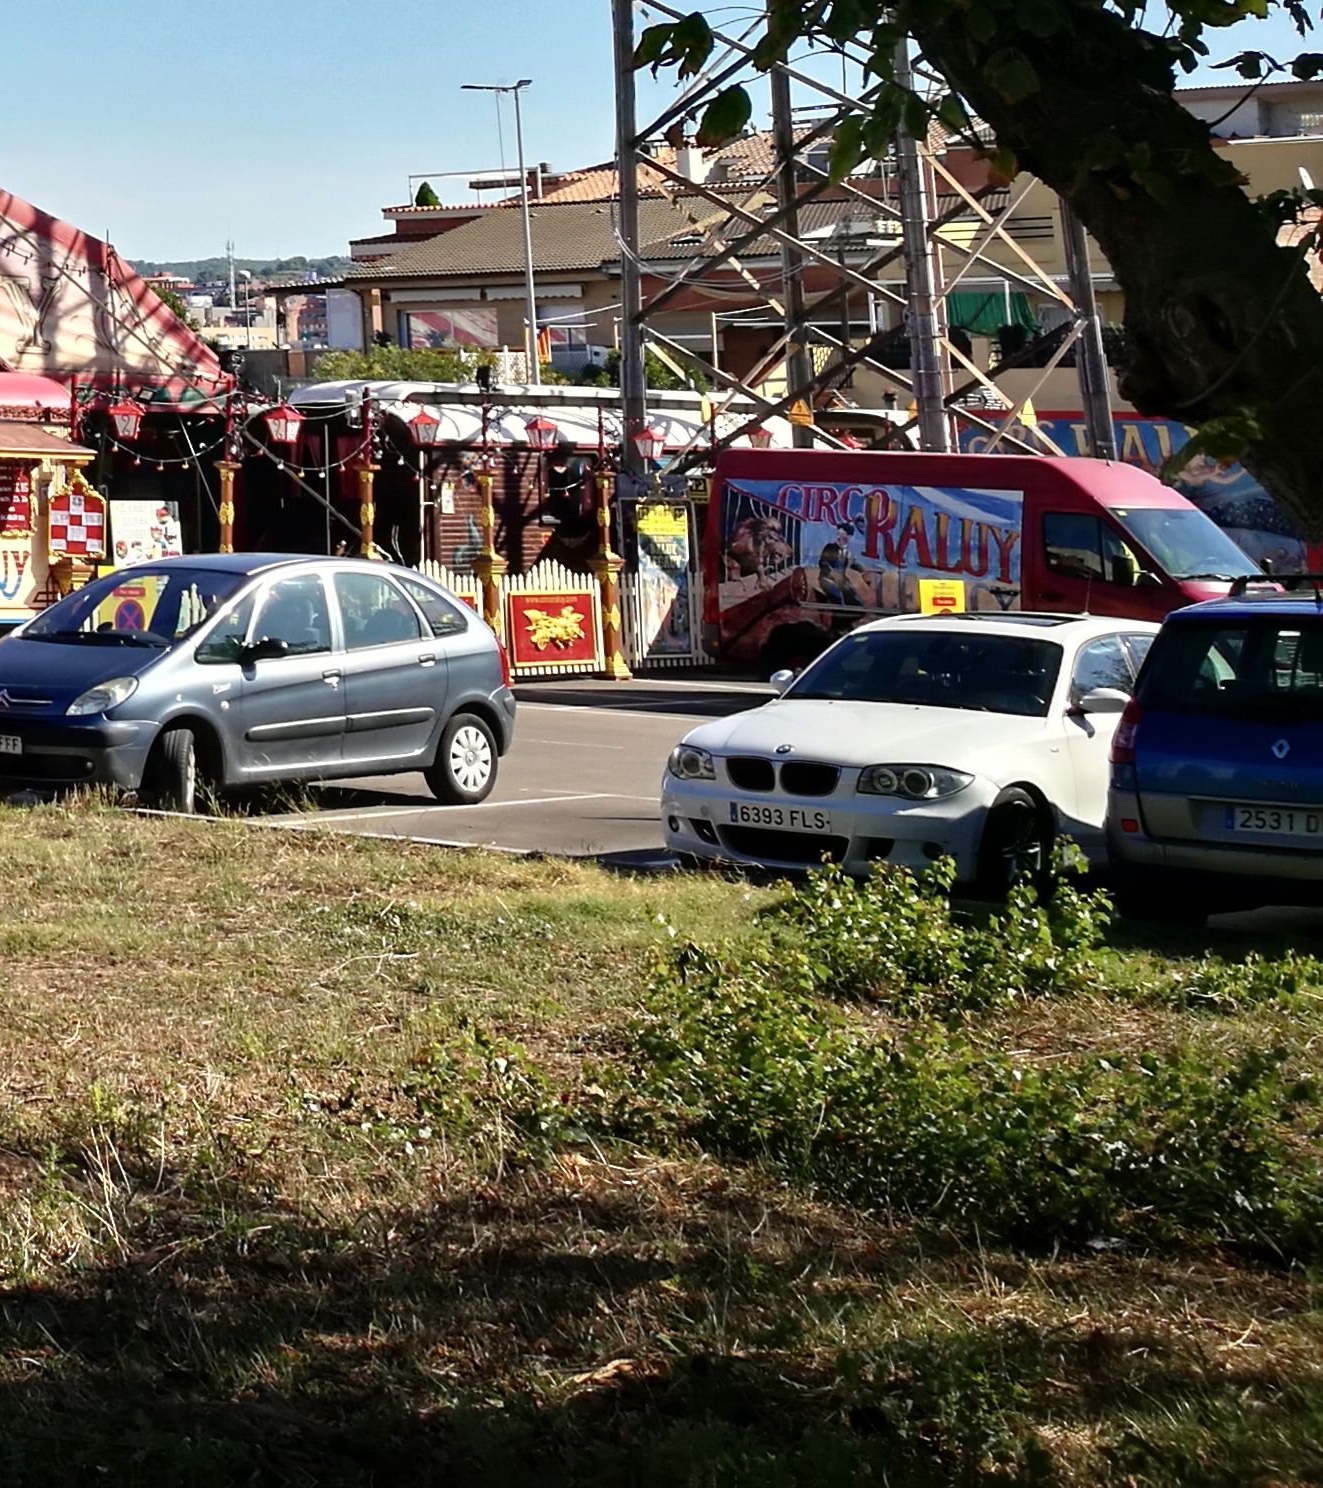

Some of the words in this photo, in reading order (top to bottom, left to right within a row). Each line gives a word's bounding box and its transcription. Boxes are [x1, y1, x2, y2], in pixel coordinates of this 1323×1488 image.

[777, 484, 891, 527] CIRCO
[861, 495, 1020, 584] RALUY
[740, 805, 783, 826] 6393
[790, 810, 825, 829] FLS
[1240, 809, 1294, 831] 2531
